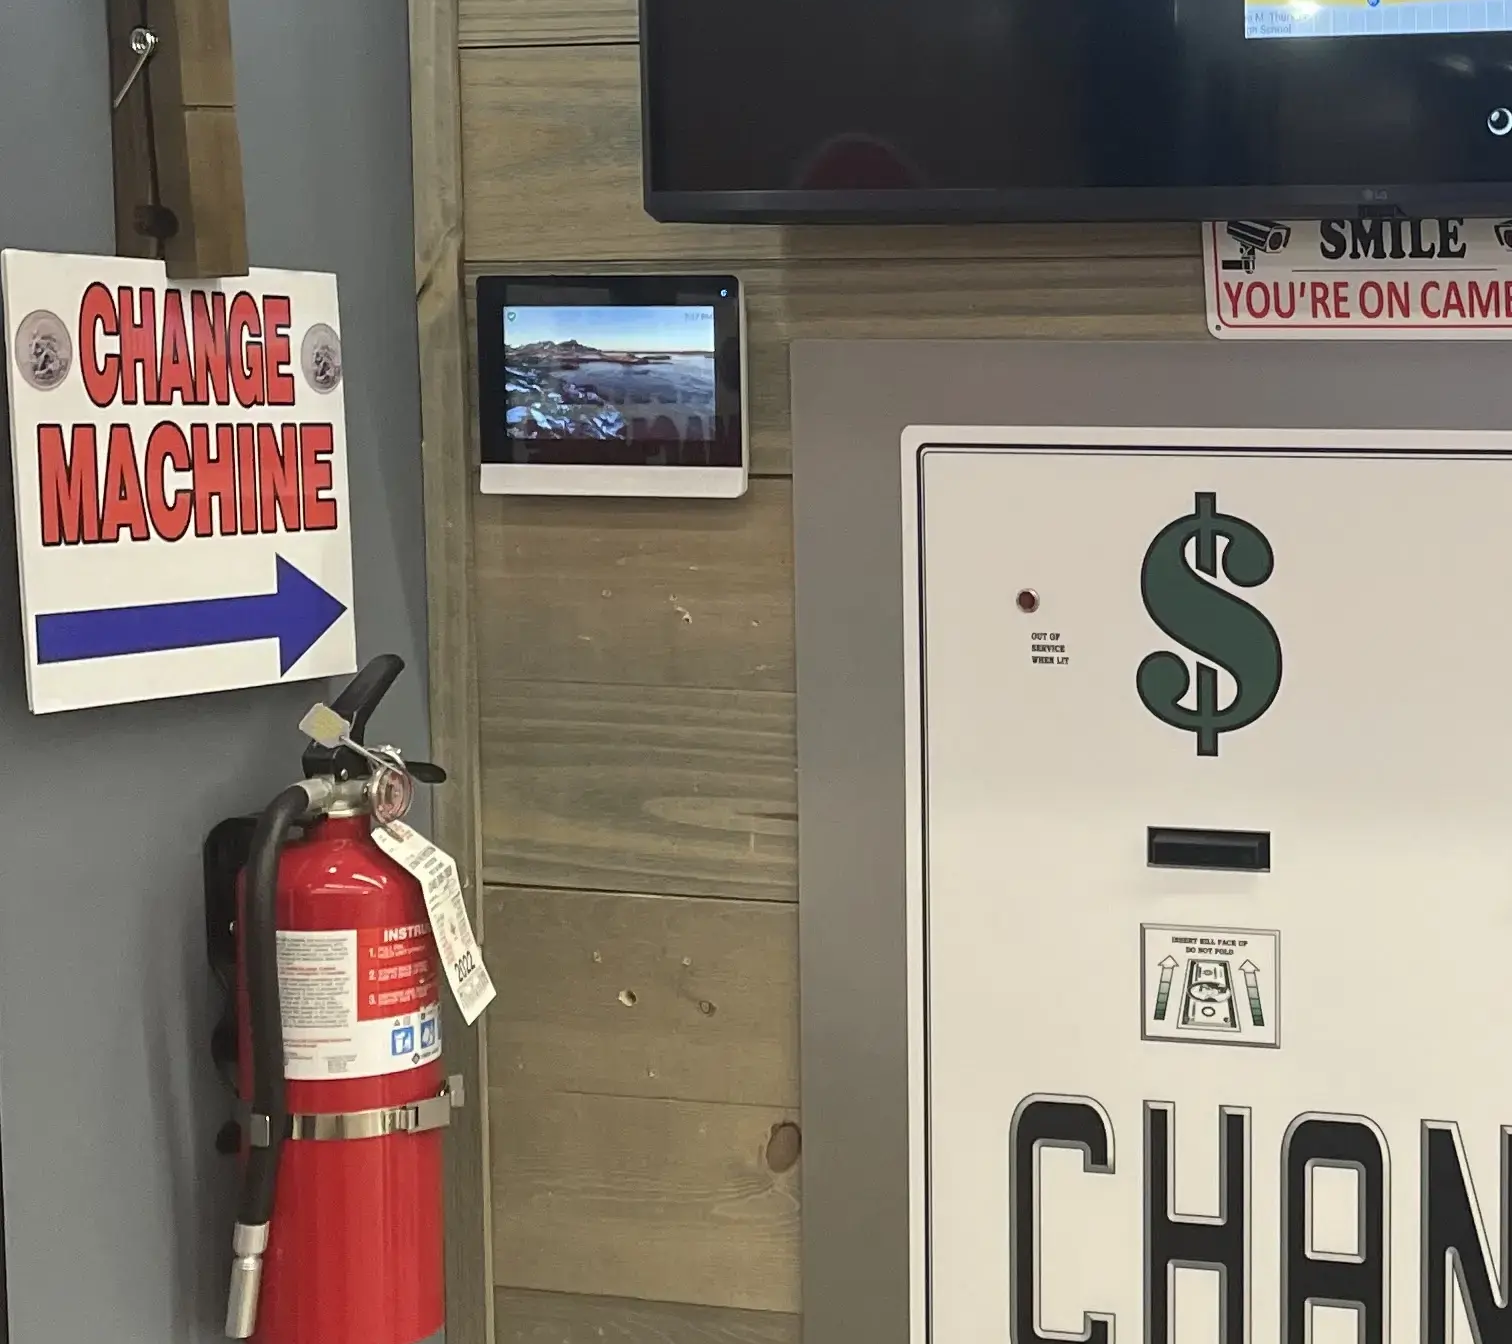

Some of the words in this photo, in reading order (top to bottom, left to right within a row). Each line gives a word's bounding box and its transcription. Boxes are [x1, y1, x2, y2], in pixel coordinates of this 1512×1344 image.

[1319, 217, 1468, 261] SMILE
[1224, 280, 1350, 320] YOU'RE
[1358, 280, 1410, 319] ON
[78, 281, 296, 409] CHANGE
[36, 420, 338, 546] MACHINE
[1031, 632, 1048, 641] OUT
[1049, 633, 1060, 641] OF
[1031, 644, 1065, 653] SERVICE
[1031, 656, 1054, 664] WHEN
[384, 923, 431, 942] INSTRU
[454, 951, 475, 982] 2022
